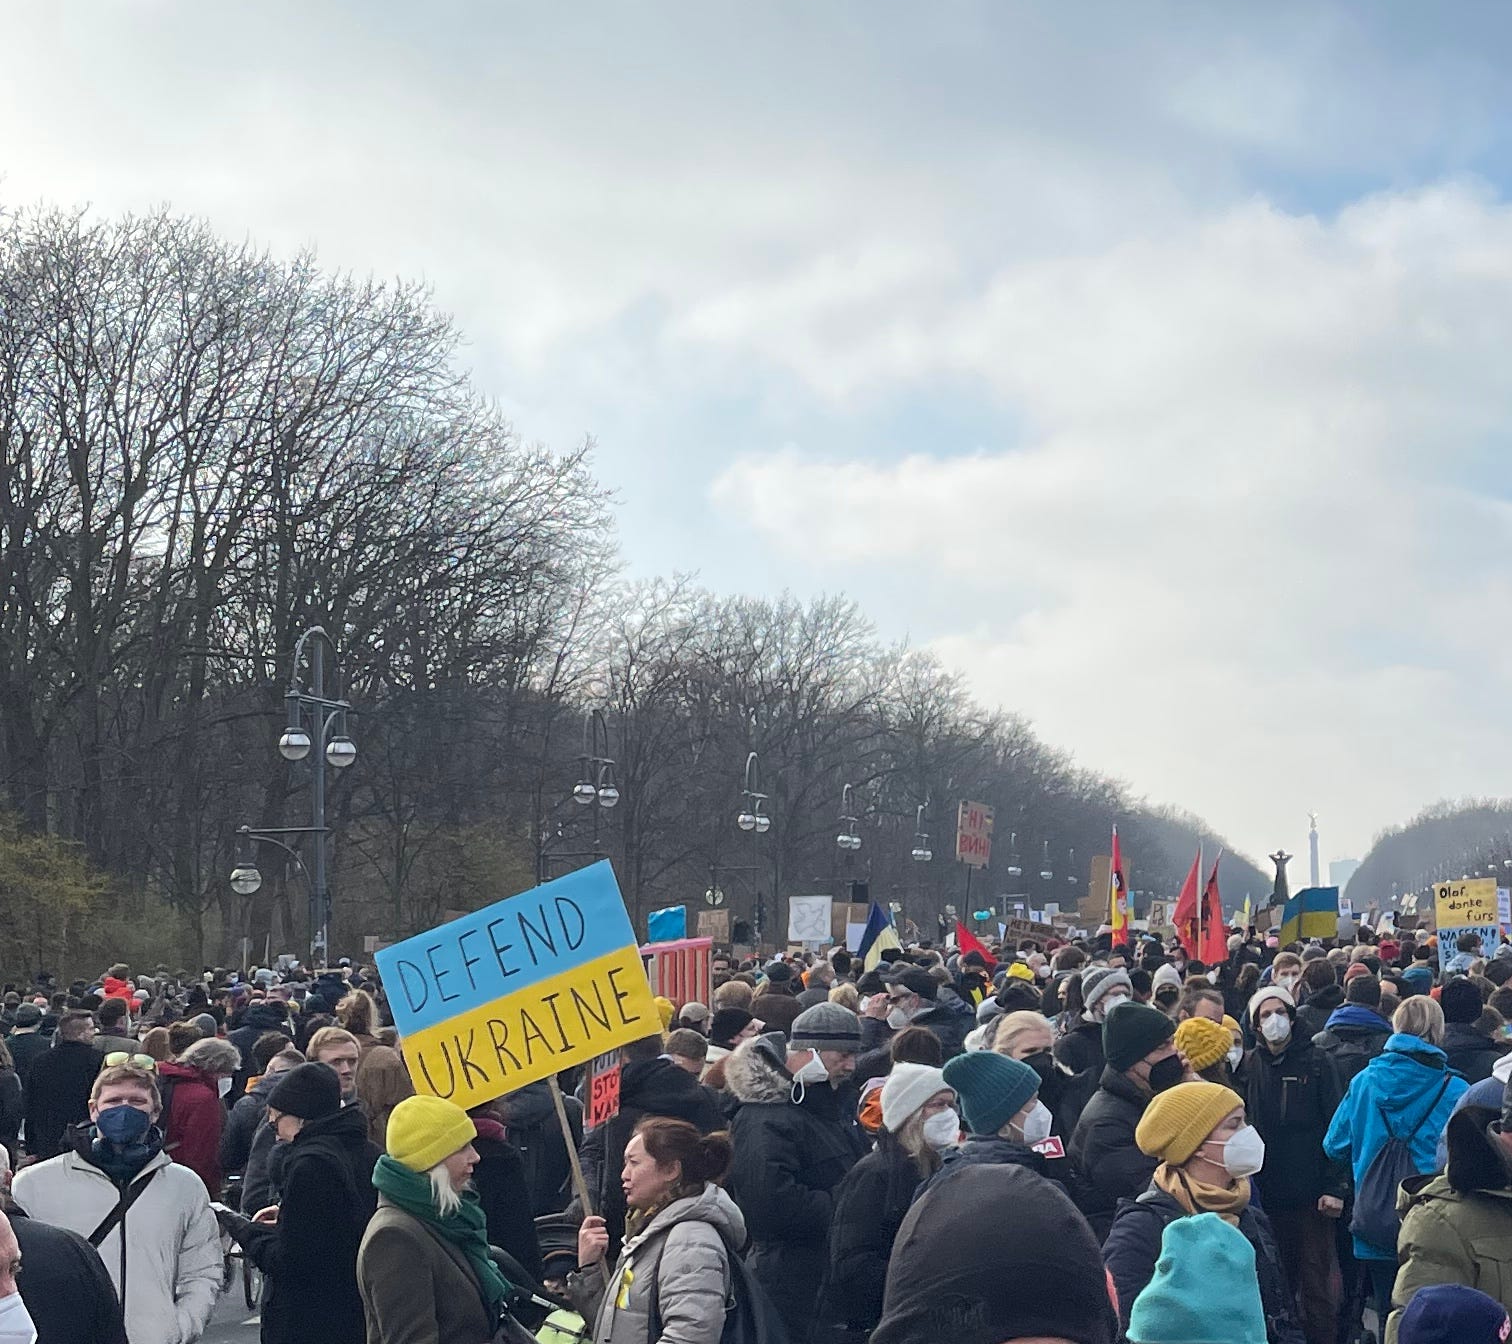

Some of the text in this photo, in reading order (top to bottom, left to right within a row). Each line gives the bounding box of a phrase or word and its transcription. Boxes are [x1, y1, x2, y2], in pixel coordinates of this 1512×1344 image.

[397, 897, 585, 1013] DEFEND
[1448, 899, 1483, 910] danke
[418, 967, 641, 1099] UKRAINE
